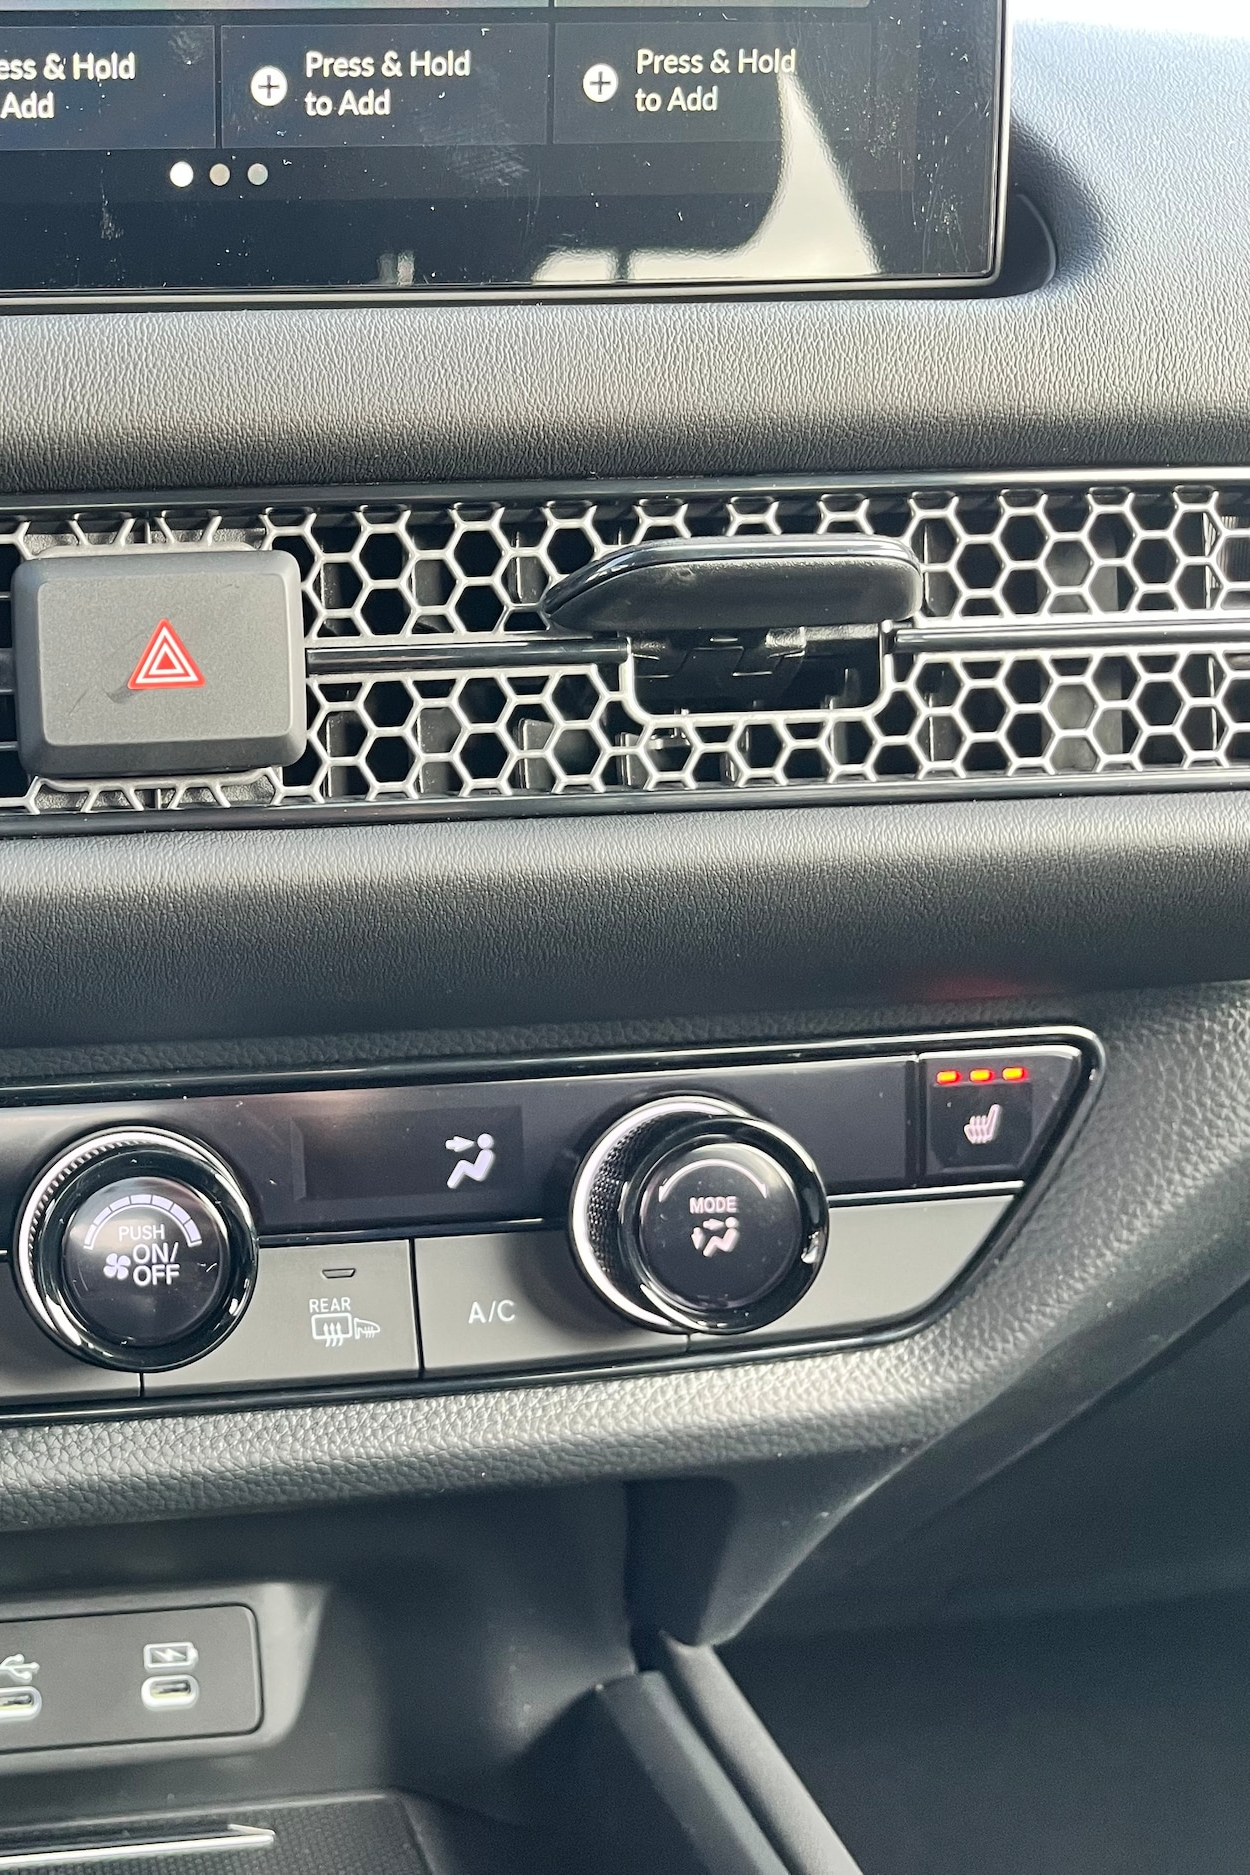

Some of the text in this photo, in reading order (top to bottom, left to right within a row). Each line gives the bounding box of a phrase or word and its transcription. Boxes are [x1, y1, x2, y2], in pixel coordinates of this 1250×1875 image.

[42, 53, 66, 80] &
[72, 52, 136, 80] Hold
[305, 50, 471, 79] Press & Hold
[636, 47, 797, 75] Press & Hold
[0, 92, 55, 119] Add
[304, 90, 391, 117] to Add
[636, 87, 719, 113] to Add
[689, 1195, 738, 1215] MODE
[118, 1224, 166, 1241] PUSH
[132, 1242, 180, 1265] ON/
[132, 1263, 181, 1286] OFF
[308, 1296, 351, 1314] REAR
[467, 1300, 517, 1325] A/C
